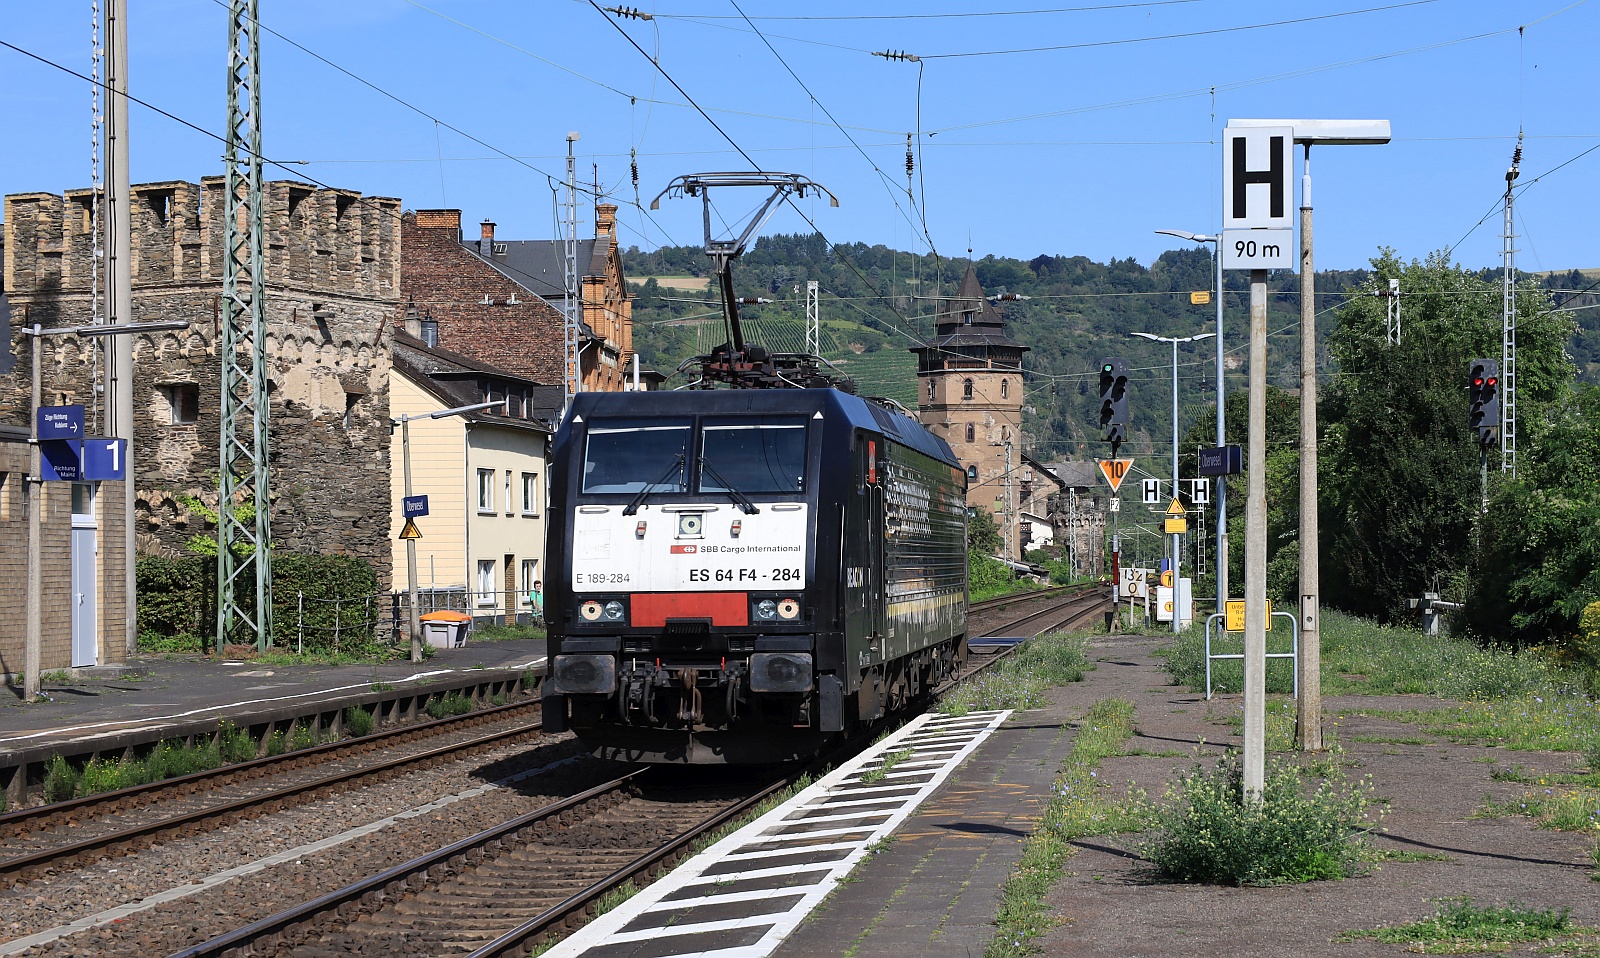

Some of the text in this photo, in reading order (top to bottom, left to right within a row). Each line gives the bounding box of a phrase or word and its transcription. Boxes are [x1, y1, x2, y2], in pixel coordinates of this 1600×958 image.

[1233, 136, 1284, 218] H
[1235, 241, 1280, 257] 90 m
[53, 413, 68, 421] Richtung
[106, 440, 119, 471] 1
[1201, 452, 1222, 468] Oberwesel
[1109, 461, 1124, 479] 10
[1144, 481, 1158, 501] H
[1194, 481, 1207, 501] H
[406, 499, 424, 512] Oberwesel
[700, 544, 801, 554] SBB Cargo International
[576, 573, 630, 584] E 189-284
[690, 569, 710, 582] ES
[715, 569, 734, 582] 64
[739, 568, 757, 581] F4
[772, 568, 801, 581] 284
[1128, 582, 1137, 594] 0
